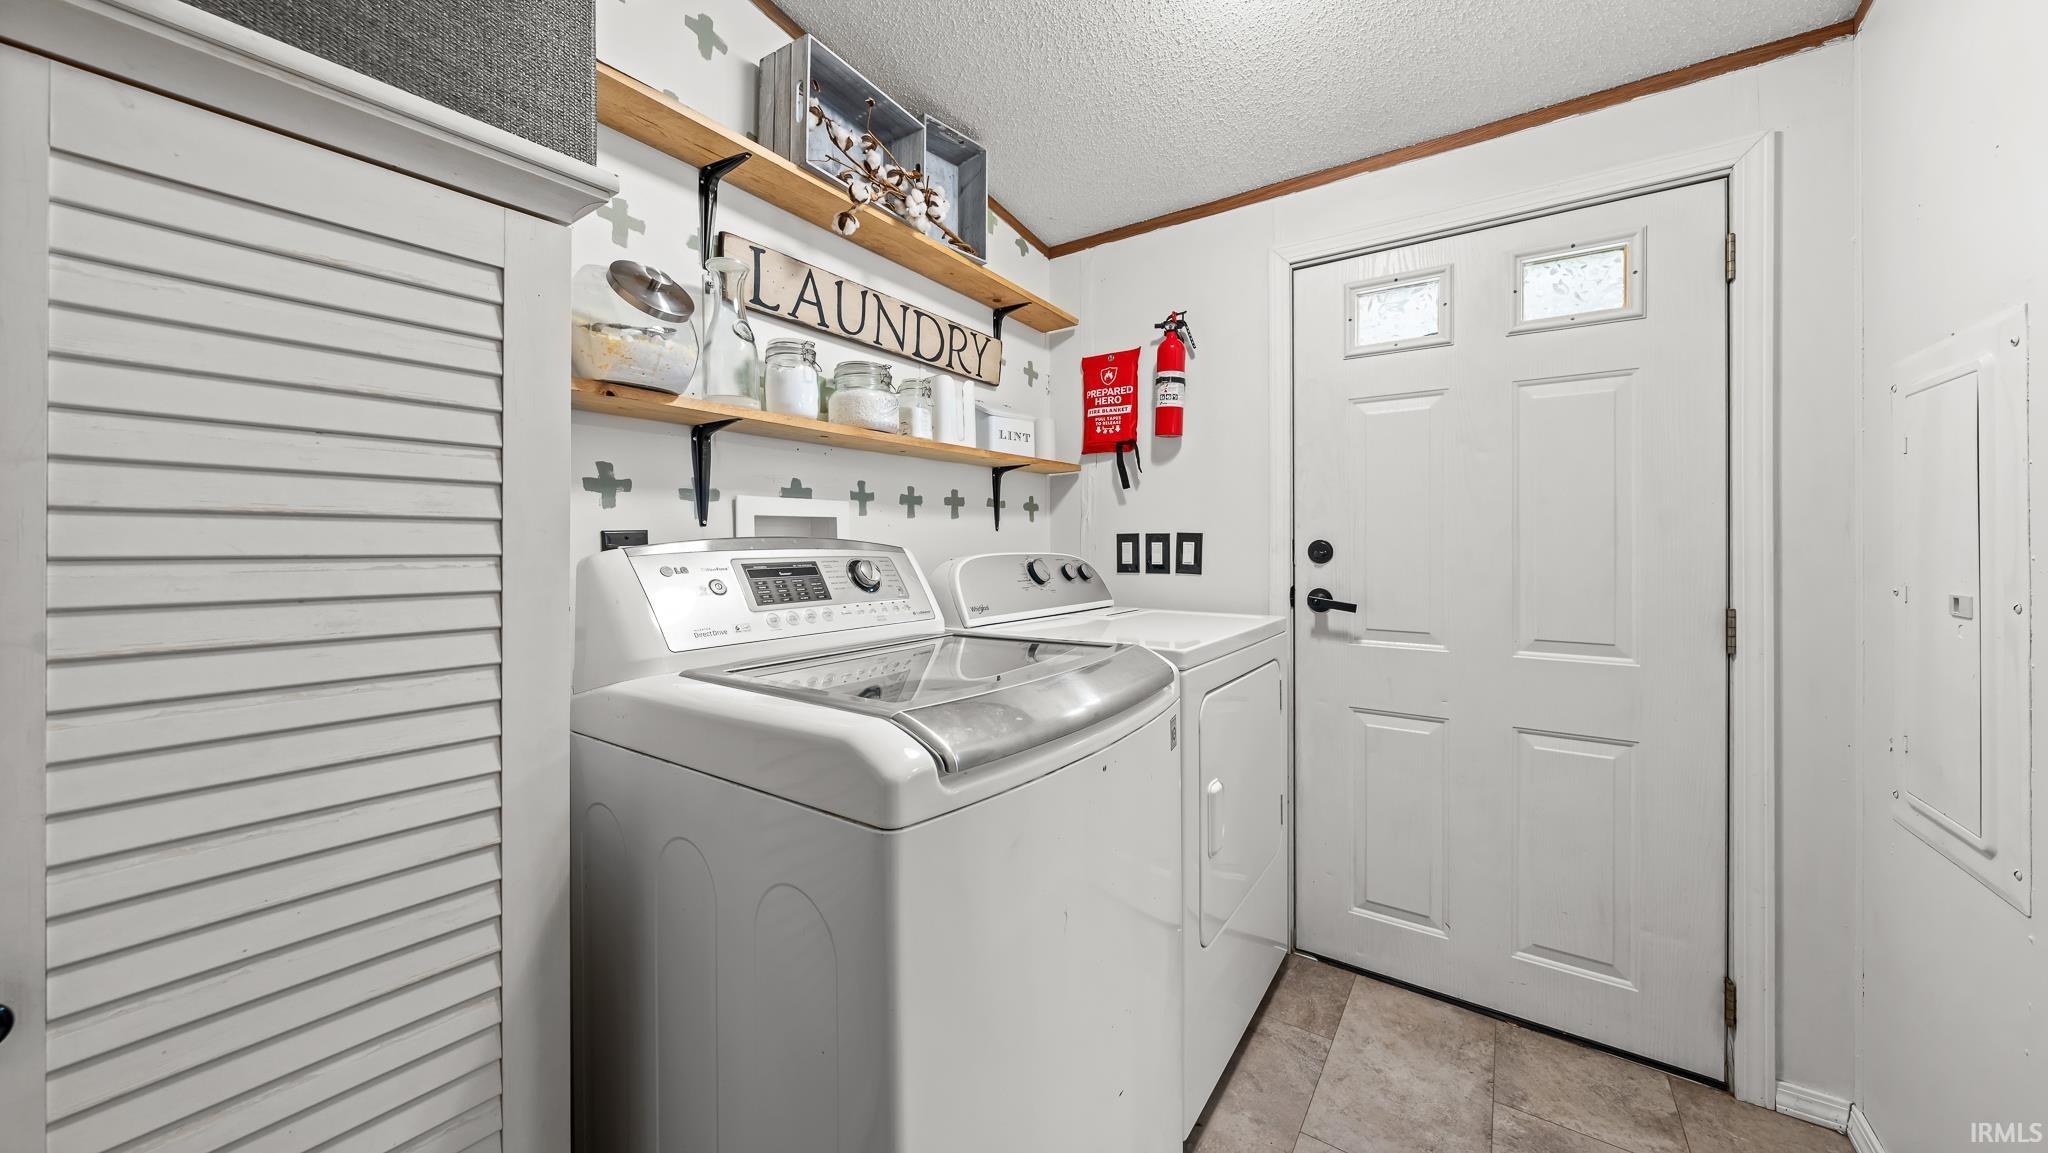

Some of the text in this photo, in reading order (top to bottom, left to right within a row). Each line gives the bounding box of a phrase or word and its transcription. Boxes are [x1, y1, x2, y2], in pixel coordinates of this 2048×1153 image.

[748, 245, 991, 378] LAUNDRY
[1086, 385, 1134, 399] PREPARED
[1095, 395, 1122, 406] HERO
[1102, 406, 1129, 414] BLANKET
[998, 429, 1031, 443] LINT
[673, 566, 690, 575] LG
